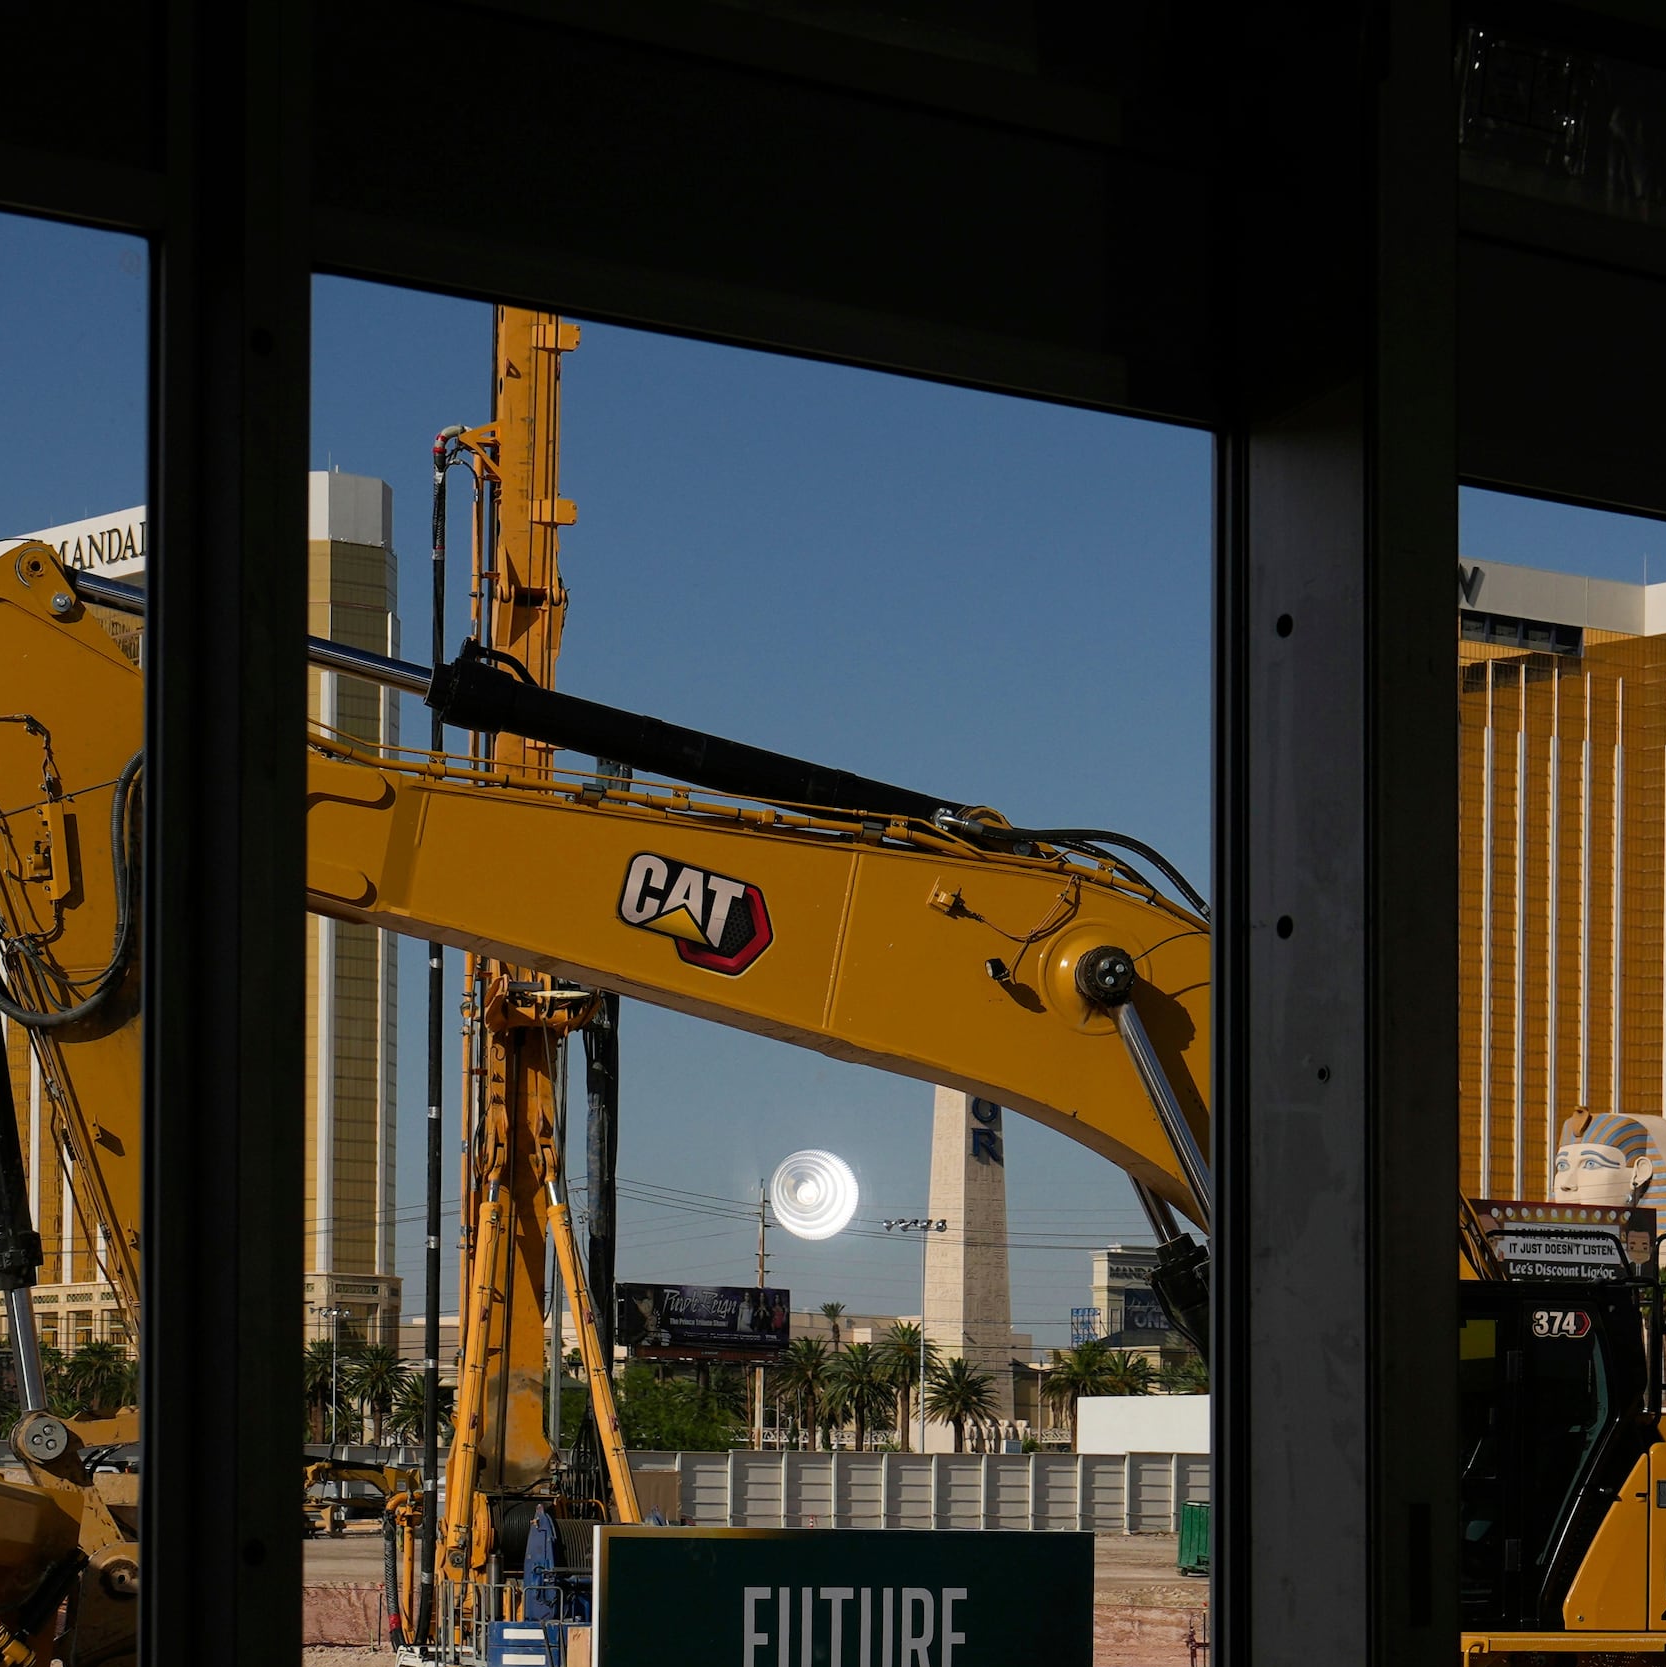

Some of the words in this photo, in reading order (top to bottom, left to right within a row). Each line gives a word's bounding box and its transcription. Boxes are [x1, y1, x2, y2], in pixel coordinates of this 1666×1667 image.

[621, 854, 745, 948] CAT
[1510, 1243, 1517, 1254] IT
[1520, 1243, 1542, 1255] JUST
[1509, 1262, 1533, 1275] Lee's
[1535, 1263, 1579, 1277] Discount
[702, 1291, 738, 1319] Reign
[1534, 1311, 1576, 1335] 374
